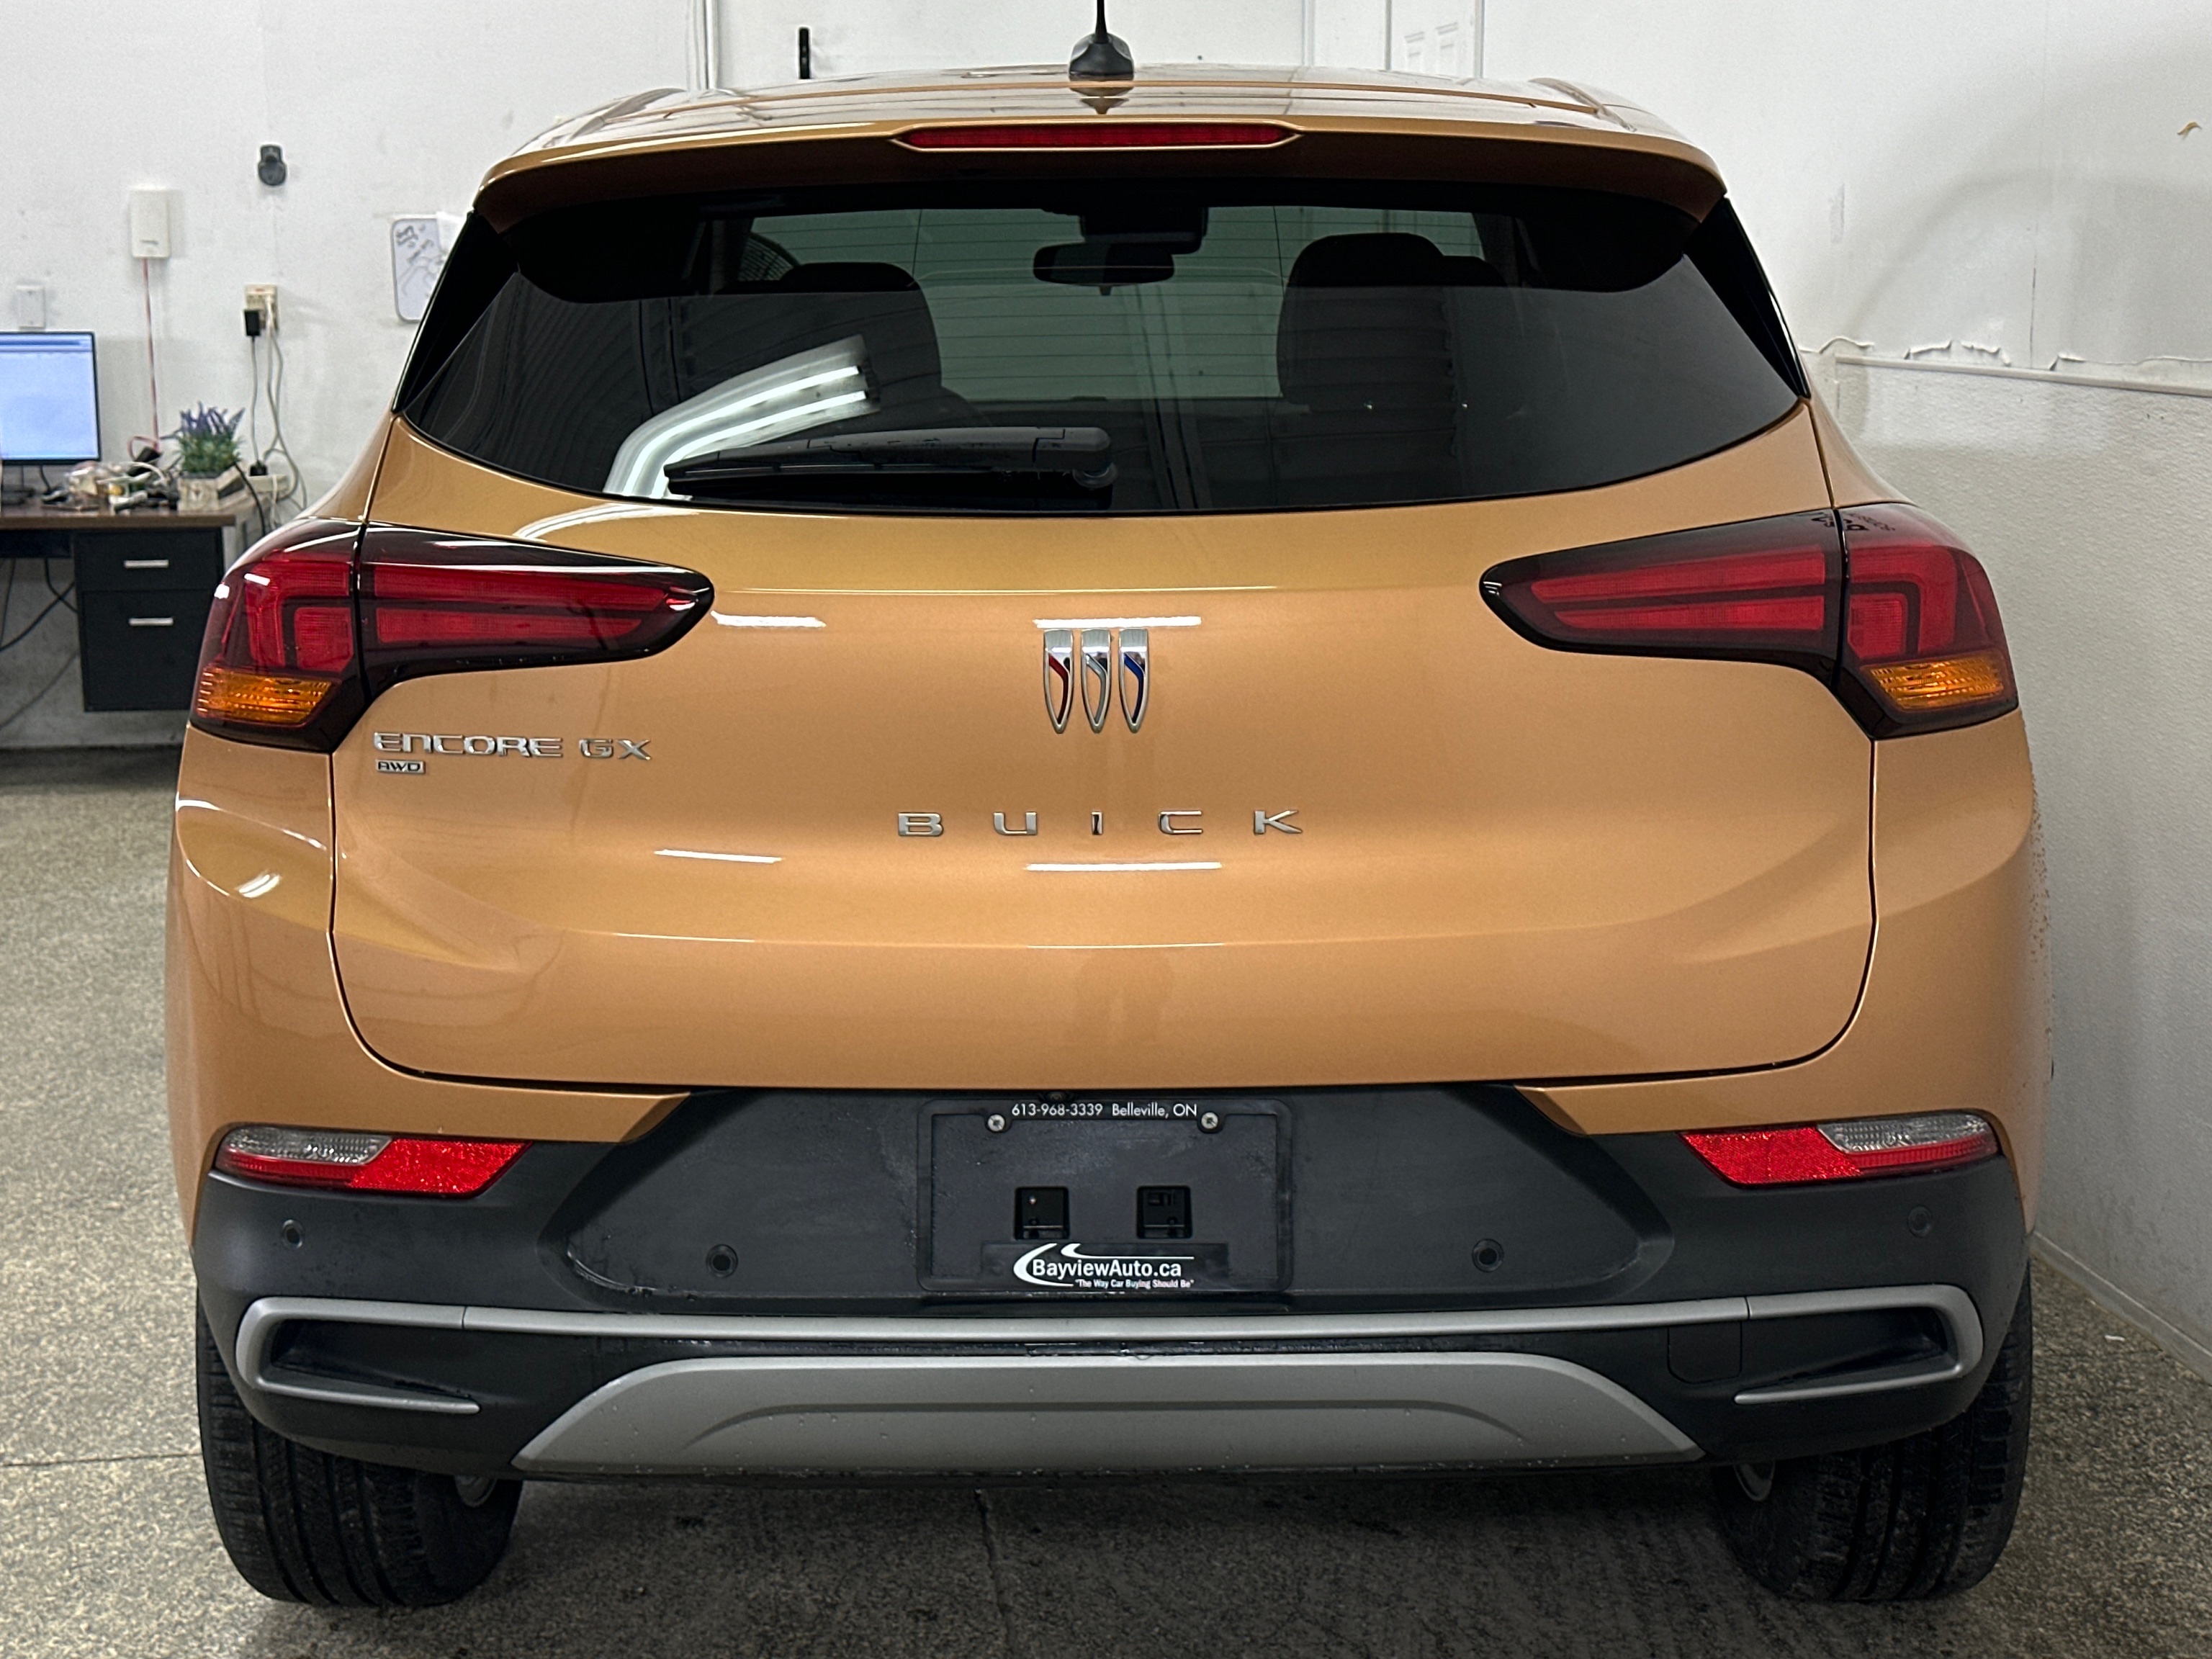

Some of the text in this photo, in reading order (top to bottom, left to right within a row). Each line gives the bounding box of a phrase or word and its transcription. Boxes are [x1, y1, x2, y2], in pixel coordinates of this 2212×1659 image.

[373, 732, 652, 760] ENCORE GX
[377, 760, 423, 773] AWD
[897, 809, 1303, 837] BUICK
[1011, 1102, 1197, 1119] 613-968-3339 Belleville, ON
[1032, 1259, 1182, 1280] BayviewAuto.ca
[1093, 1279, 1110, 1289] Way
[1110, 1279, 1124, 1287] Car
[1125, 1279, 1151, 1290] Buying
[1152, 1279, 1179, 1287] Should
